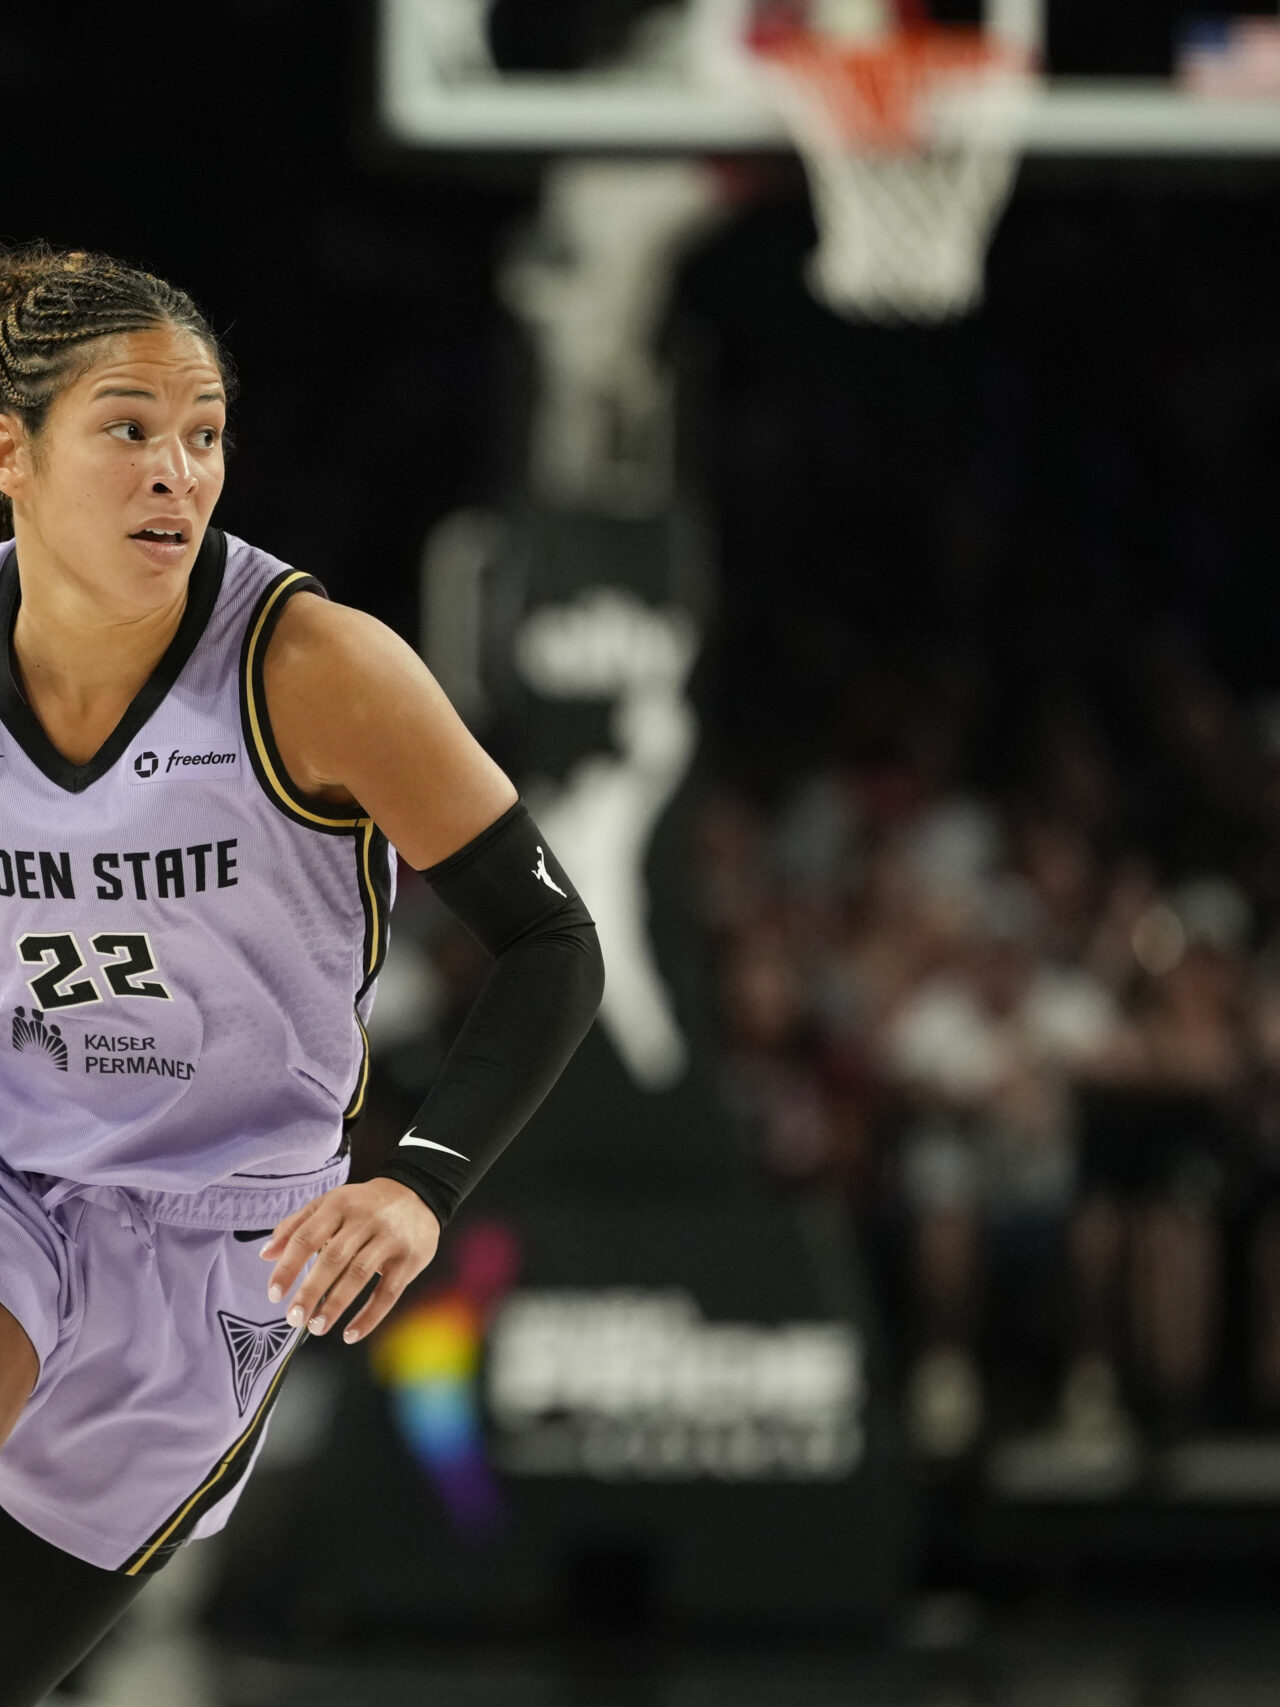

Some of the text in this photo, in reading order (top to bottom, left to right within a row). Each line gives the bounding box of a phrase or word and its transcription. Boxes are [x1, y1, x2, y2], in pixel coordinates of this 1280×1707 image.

[164, 749, 237, 774] freedom
[92, 838, 239, 902] STATE
[16, 931, 175, 1012] 22
[84, 1034, 156, 1052] KAISER
